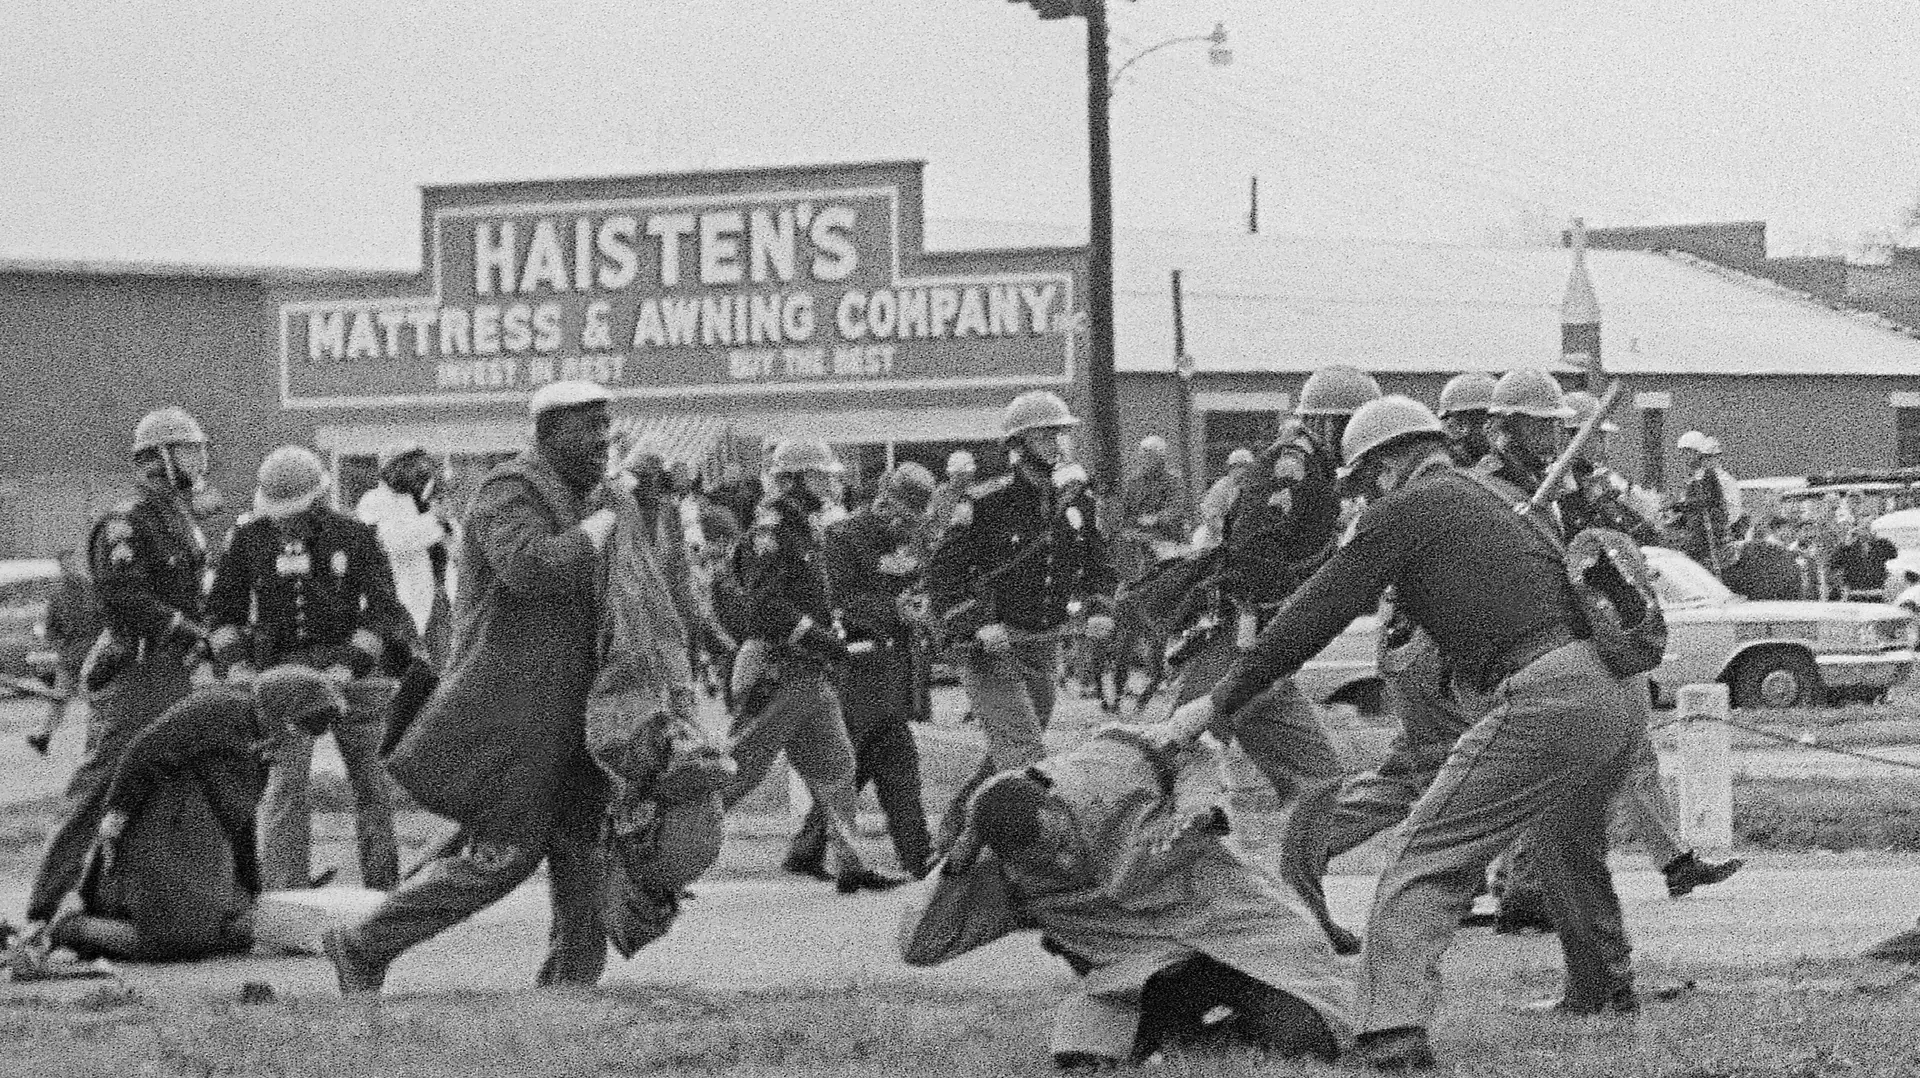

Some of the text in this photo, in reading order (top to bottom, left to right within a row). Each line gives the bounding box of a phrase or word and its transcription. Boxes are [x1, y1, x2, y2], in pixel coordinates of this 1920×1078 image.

[474, 202, 859, 293] HAISTEN'S
[308, 283, 1058, 359] MATTRESS & AWNING COMPANY
